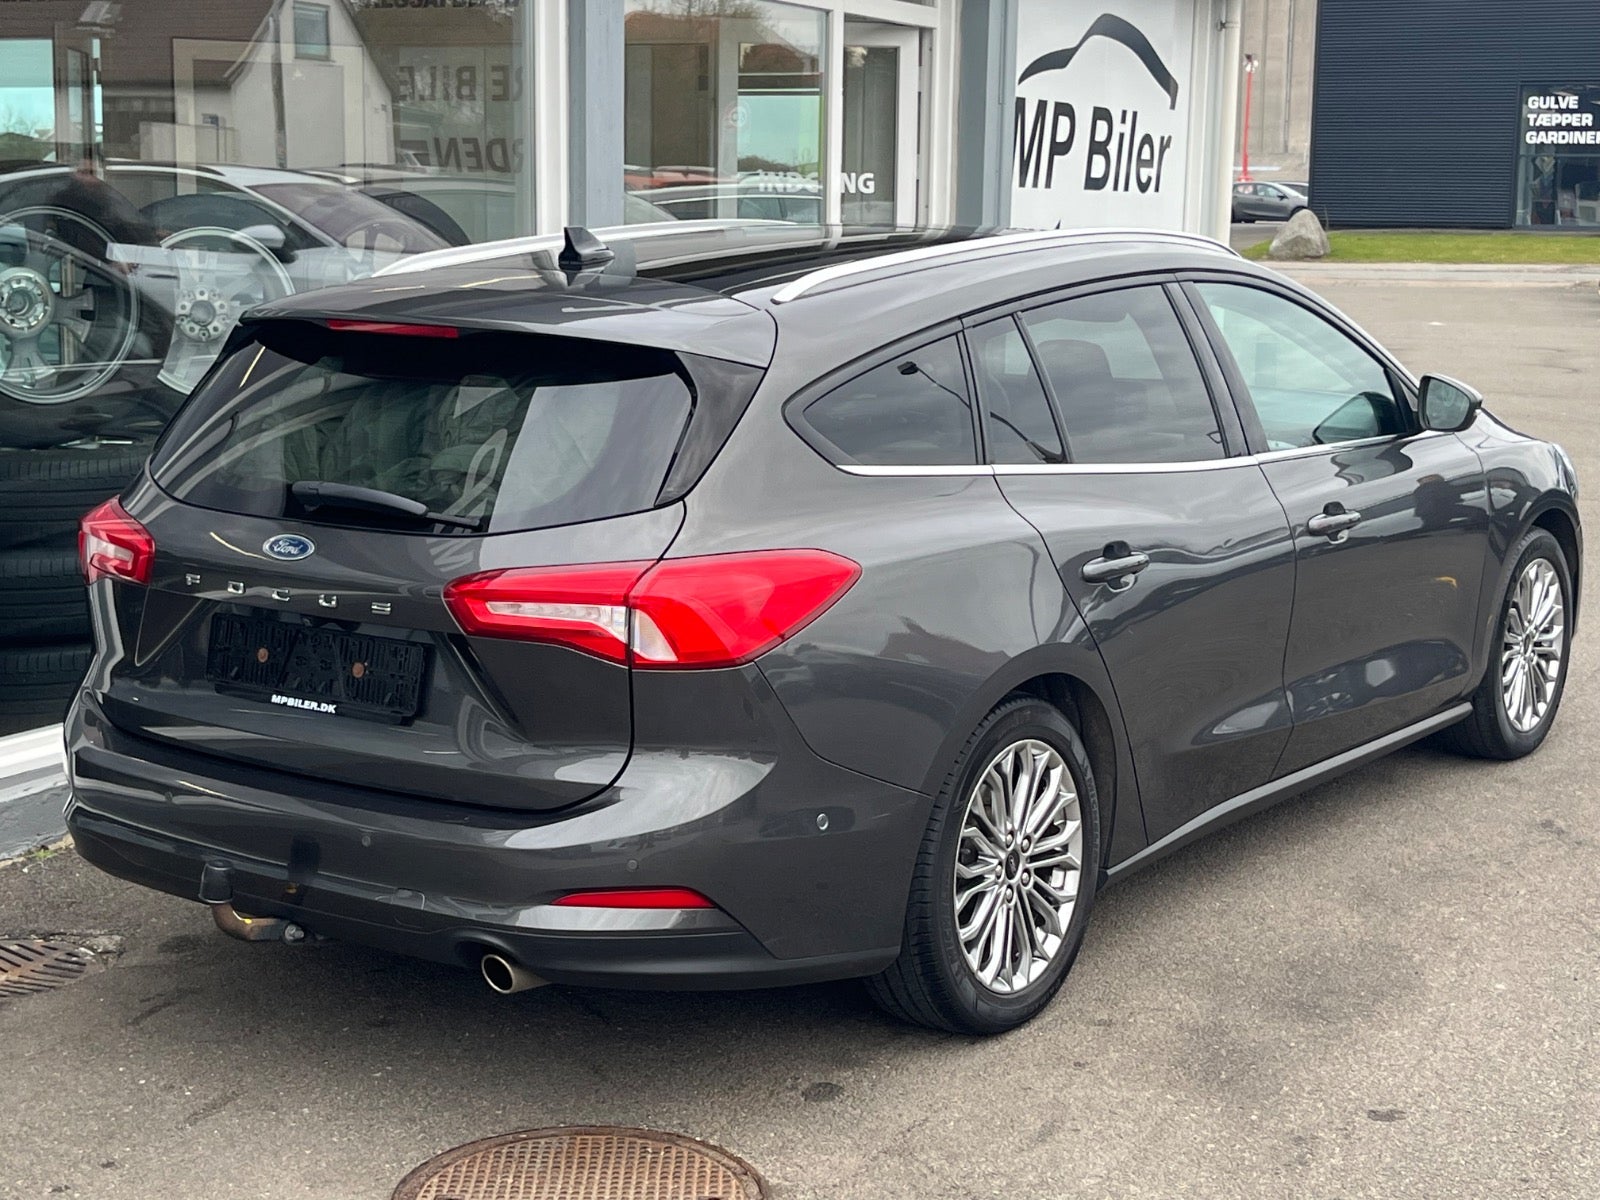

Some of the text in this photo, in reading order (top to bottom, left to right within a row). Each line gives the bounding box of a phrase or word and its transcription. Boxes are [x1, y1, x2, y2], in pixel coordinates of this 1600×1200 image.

[1527, 95, 1579, 110] GULVE
[1527, 113, 1593, 127] TÆPPER
[1012, 96, 1172, 194] MP Biler
[185, 573, 392, 616] FOCUS
[271, 694, 337, 714] MPBILER.DK
